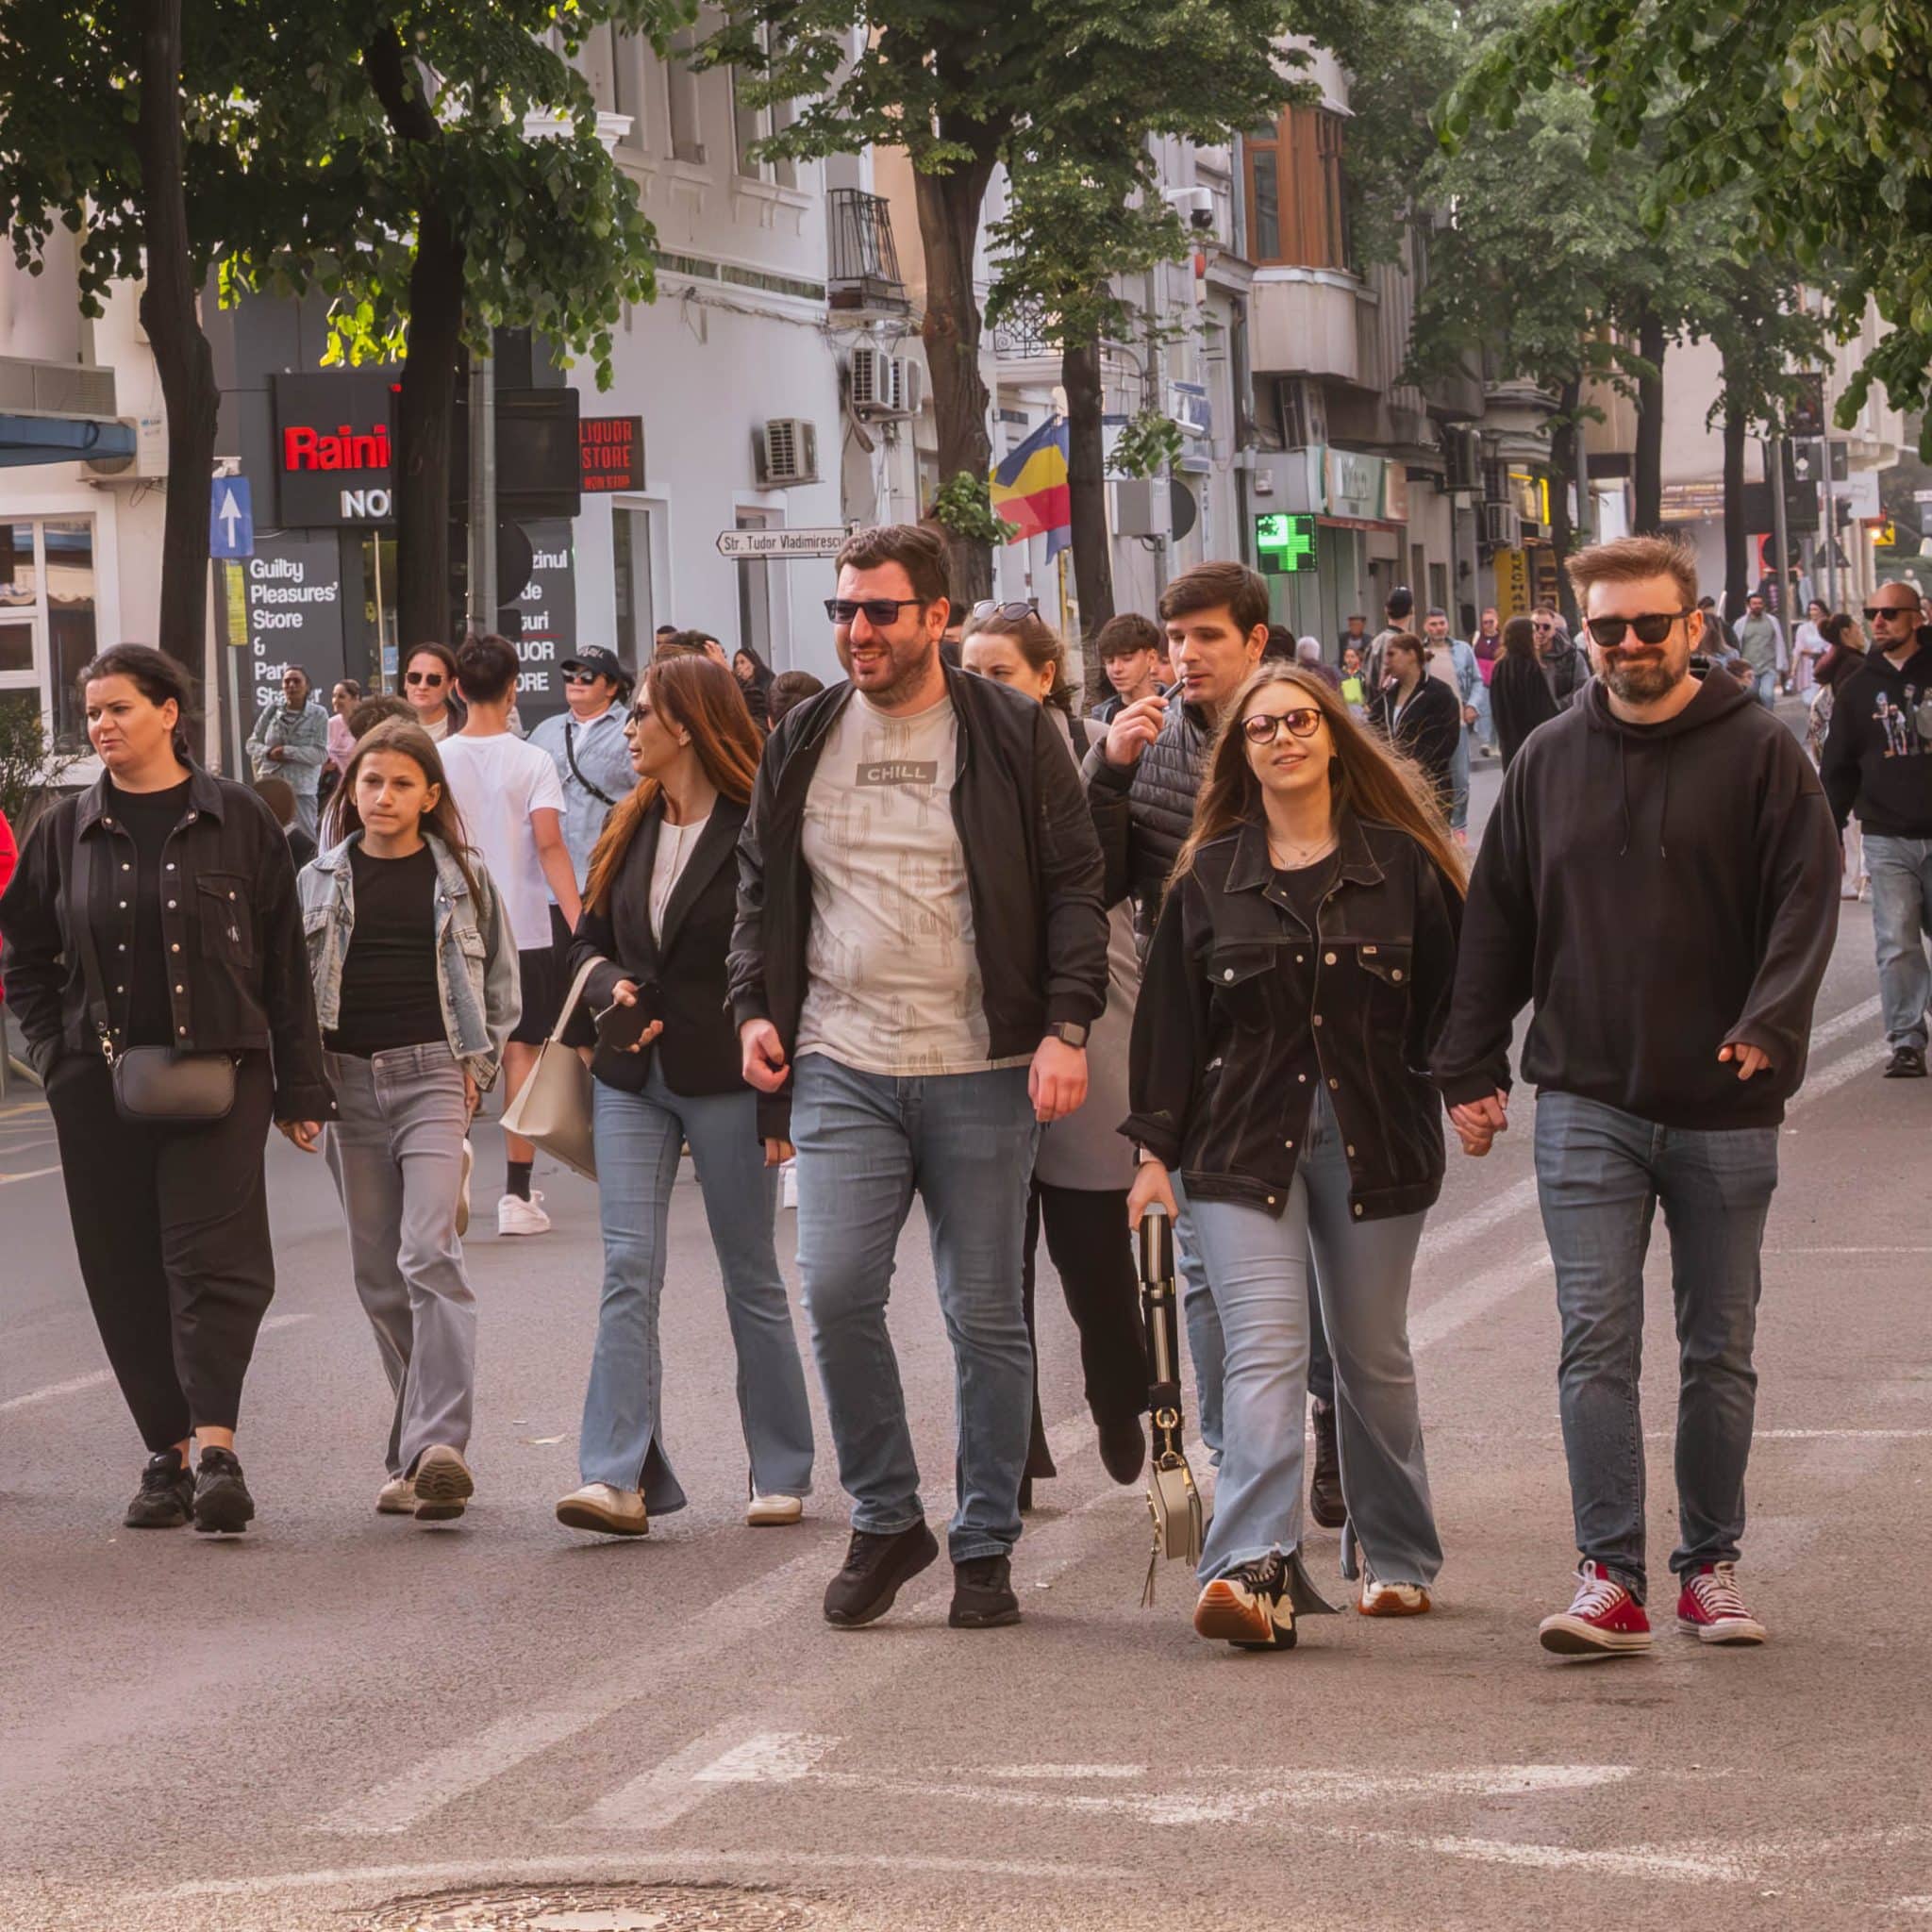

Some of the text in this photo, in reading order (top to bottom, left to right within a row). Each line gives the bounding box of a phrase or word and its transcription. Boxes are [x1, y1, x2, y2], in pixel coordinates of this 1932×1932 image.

[578, 421, 633, 443] LIQUOR
[284, 424, 391, 471] Raini
[581, 444, 634, 469] STORE
[341, 489, 392, 518] NO
[724, 536, 743, 551] Str.
[746, 535, 776, 550] Tudor
[532, 549, 568, 569] zinul
[249, 558, 304, 583] Guilty
[1510, 552, 1525, 612] EXCHAN
[253, 609, 304, 630] Store
[253, 636, 266, 657] &
[515, 641, 555, 661] UOR
[515, 672, 550, 692] ORE
[867, 765, 927, 782] CHILL
